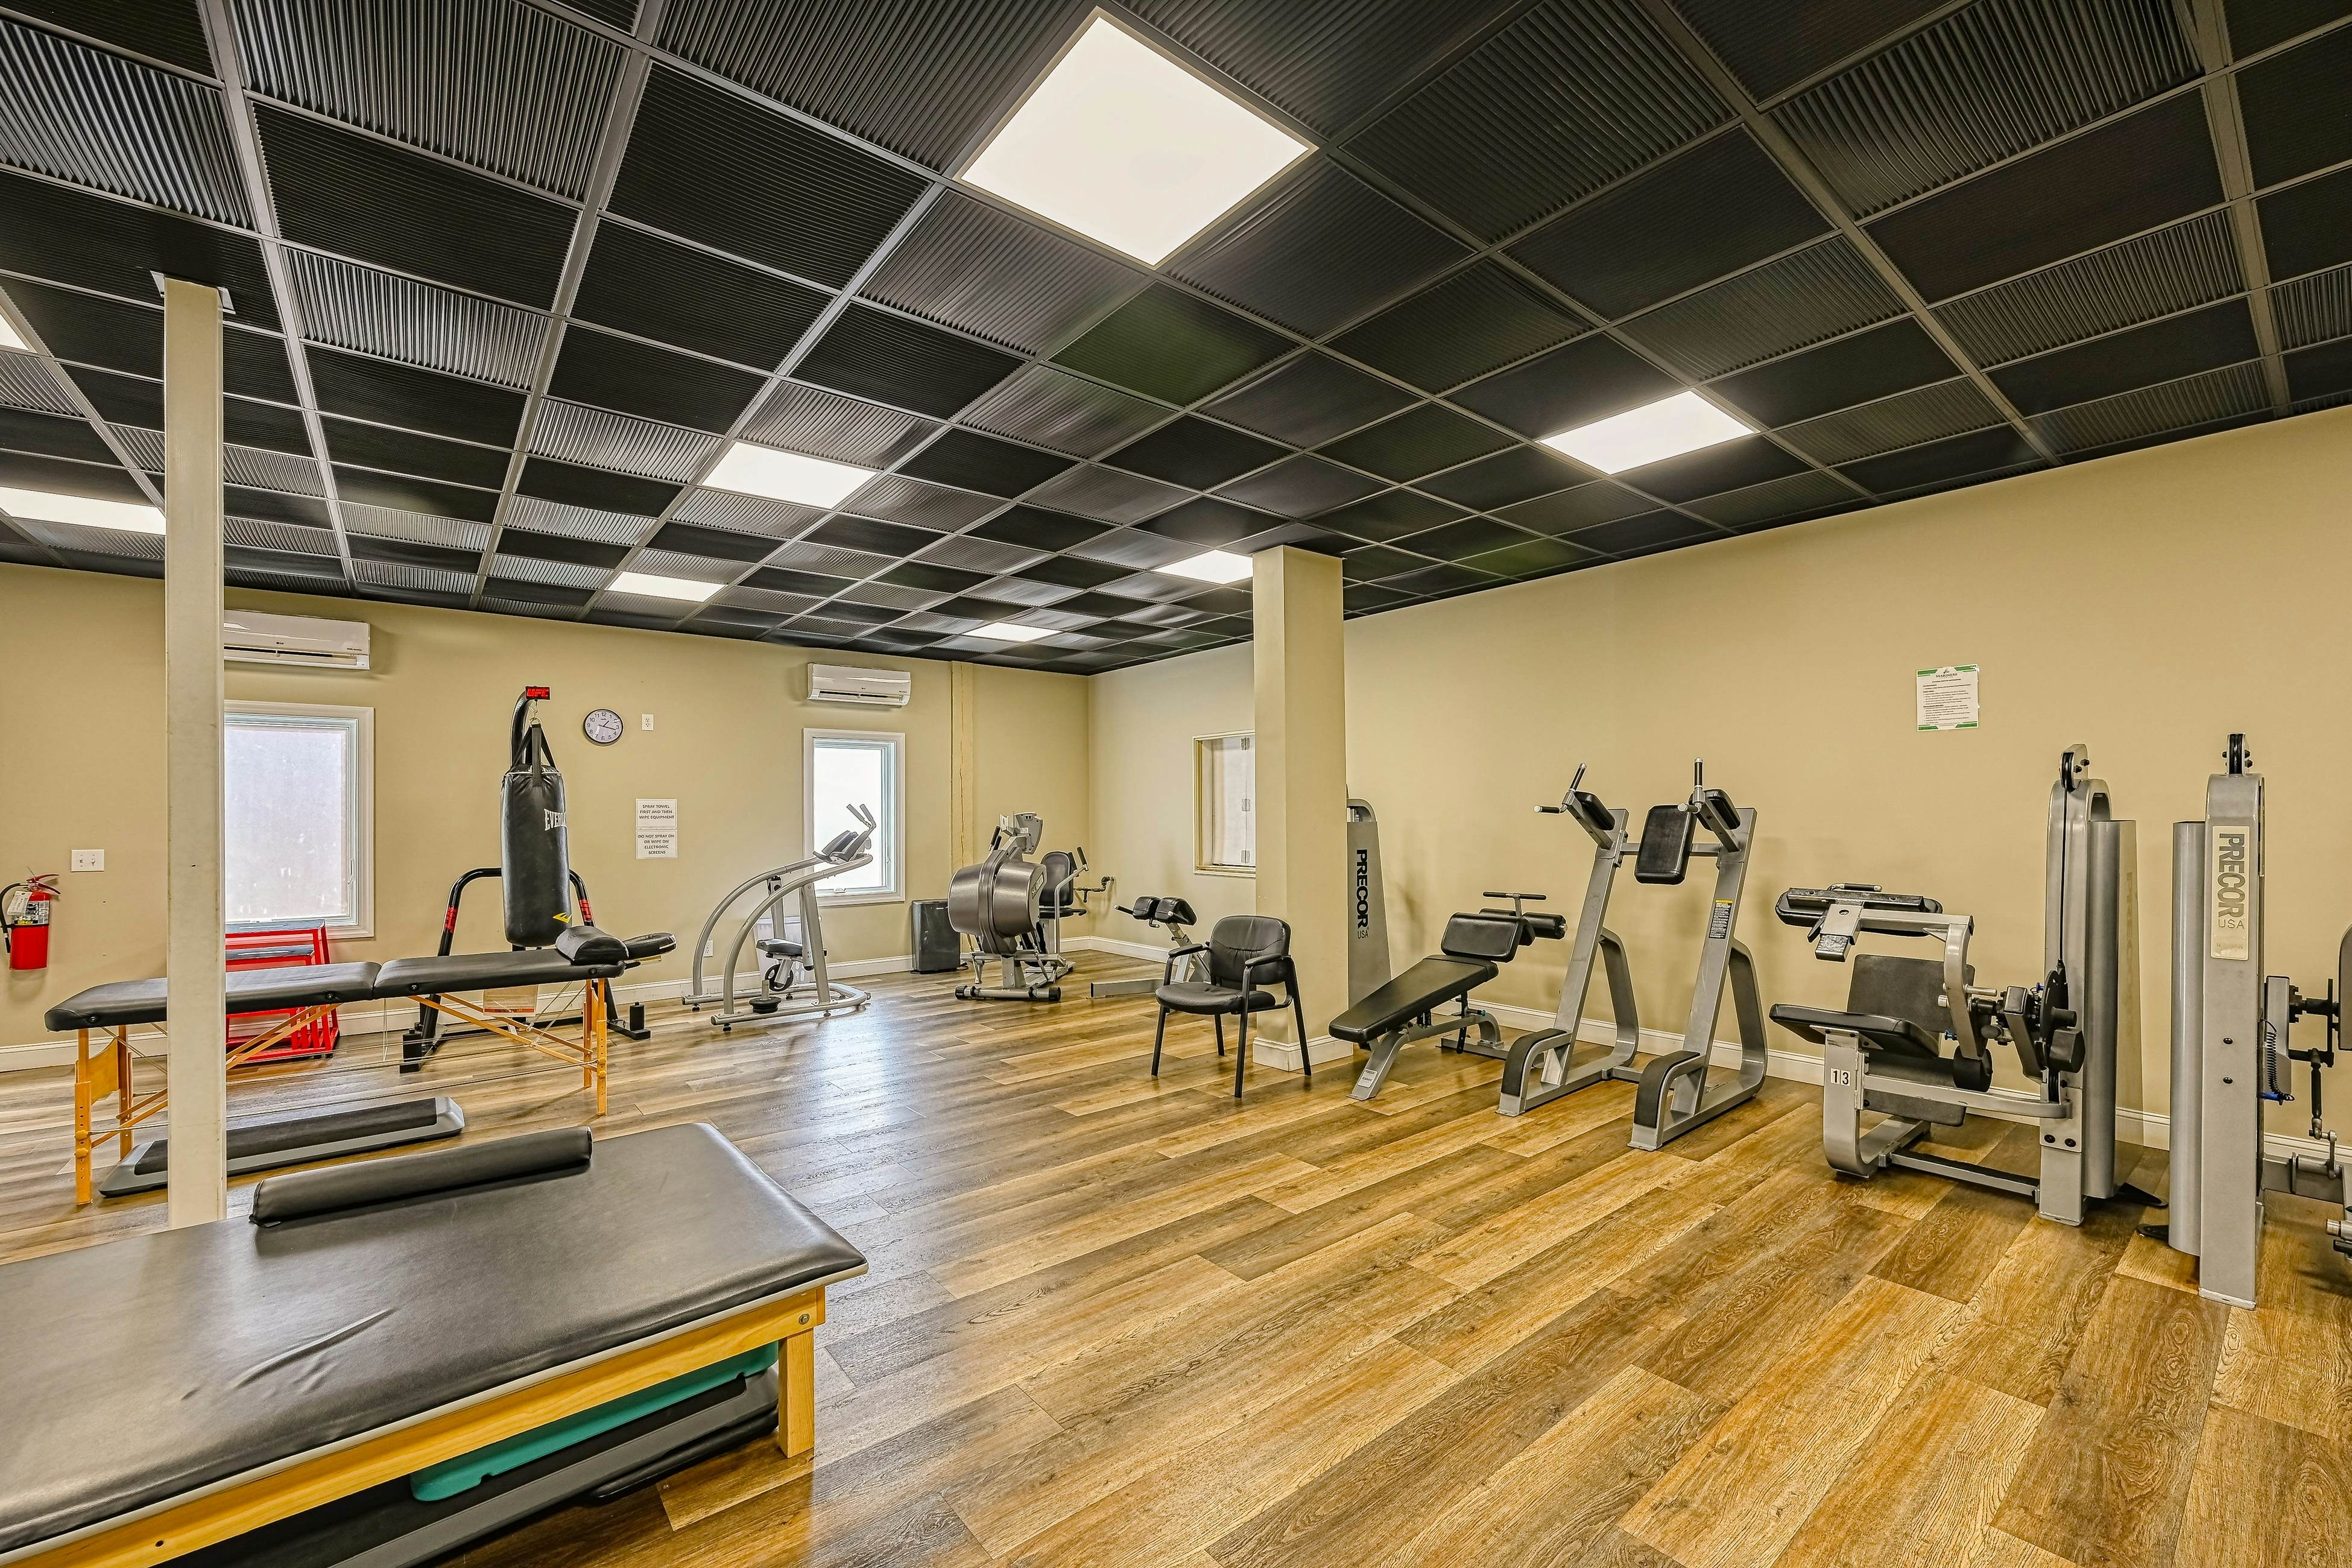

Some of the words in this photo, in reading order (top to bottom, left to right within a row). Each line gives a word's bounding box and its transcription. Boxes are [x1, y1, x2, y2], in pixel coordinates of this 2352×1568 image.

[526, 689, 549, 697] UFC
[544, 808, 567, 831] EVERL
[2217, 833, 2246, 918] PRECOR
[1356, 849, 1368, 929] PRECOR
[2218, 918, 2245, 929] USA
[1357, 930, 1369, 940] USA
[1833, 1070, 1849, 1085] 13
